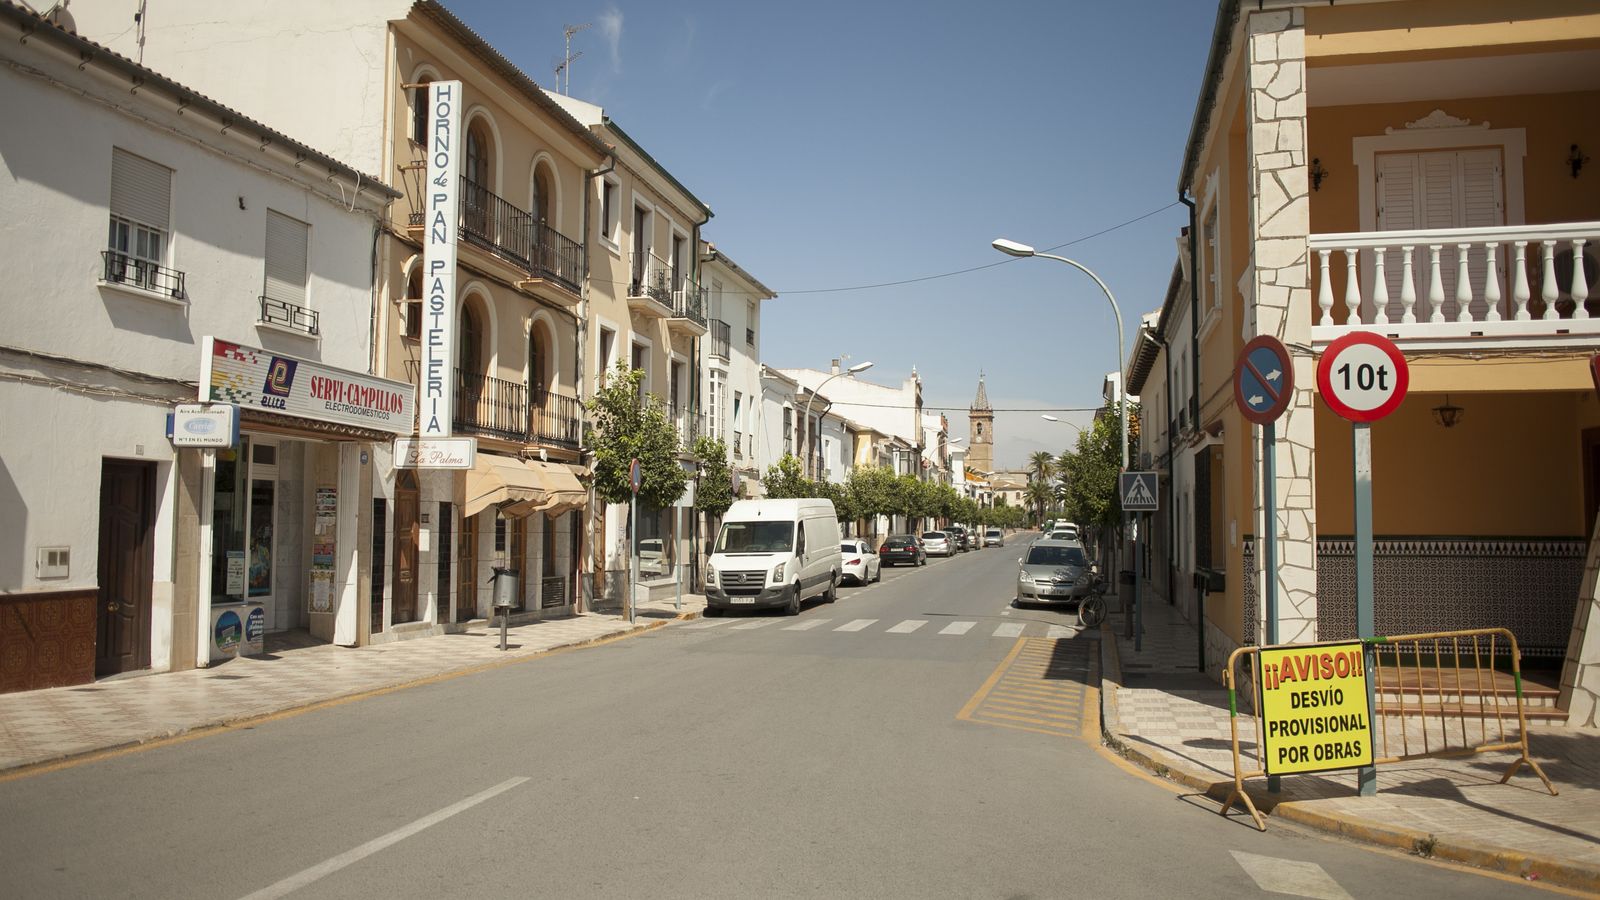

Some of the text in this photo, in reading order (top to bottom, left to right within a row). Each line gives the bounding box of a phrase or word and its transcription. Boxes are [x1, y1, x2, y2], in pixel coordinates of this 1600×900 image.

[426, 84, 452, 433] HORNO de PAN PASTELERIA
[1337, 363, 1388, 391] 10t
[261, 396, 287, 410] elite
[325, 401, 390, 420] ELECTRODOMESTICOS
[408, 451, 464, 464] La Palma
[1264, 651, 1363, 690] ¡¡AVISO!!
[1290, 685, 1344, 709] DESVÍO
[1269, 713, 1366, 738] PROVISIONAL
[1278, 740, 1362, 765] POR OBRAS
